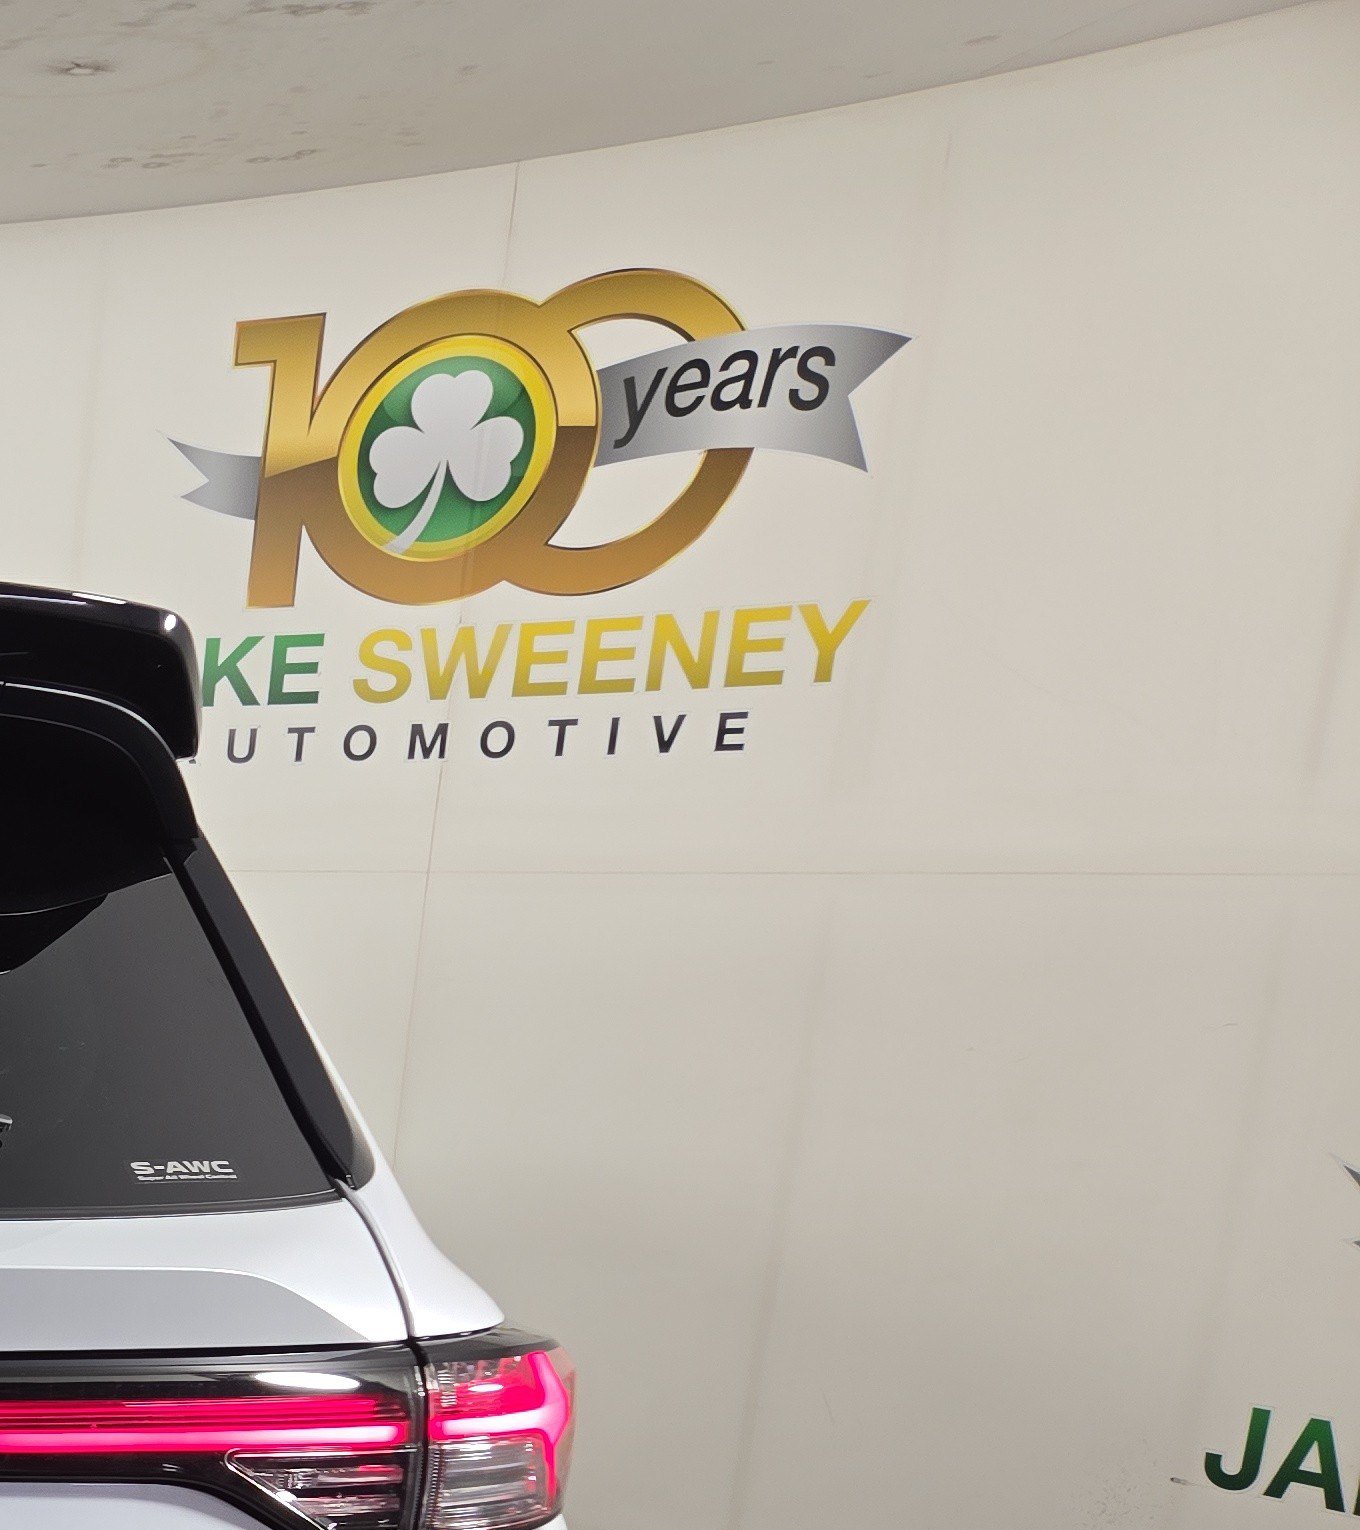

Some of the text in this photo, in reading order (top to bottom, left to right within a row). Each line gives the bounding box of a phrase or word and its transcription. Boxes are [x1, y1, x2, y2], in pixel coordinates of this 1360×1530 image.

[233, 267, 836, 610] 100 years
[202, 599, 871, 707] KE SWEENEY
[189, 711, 750, 764] UTOMOTIVE
[130, 1160, 235, 1175] S-AWC
[1204, 1406, 1360, 1517] JA
